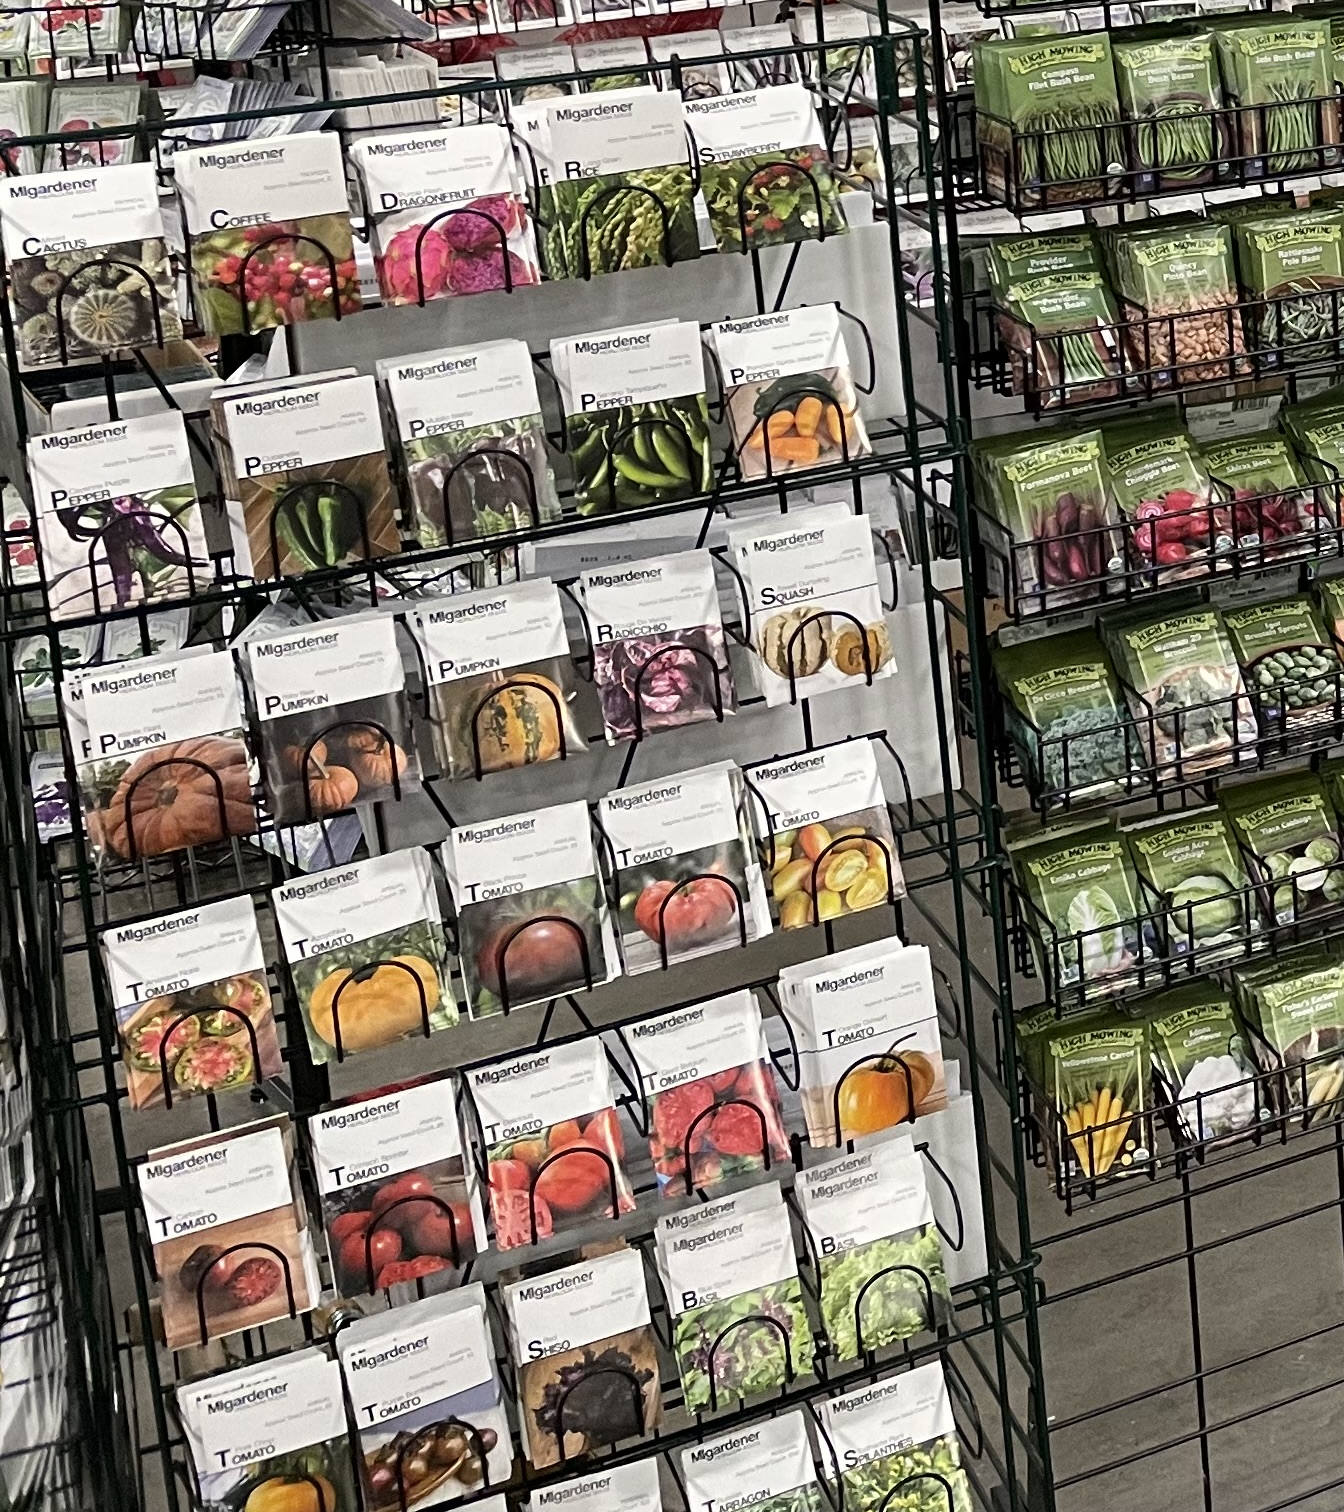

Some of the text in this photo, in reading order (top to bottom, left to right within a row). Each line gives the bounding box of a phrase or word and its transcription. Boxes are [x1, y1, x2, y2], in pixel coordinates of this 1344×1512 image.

[1273, 32, 1315, 43] MOWING
[1019, 44, 1094, 65] HIGH MOWING
[556, 101, 633, 122] MIgardener
[685, 94, 757, 114] MIgardener
[367, 136, 447, 156] MIgardener
[700, 142, 781, 163] STRAWBERRY
[199, 147, 285, 169] MIgardener
[565, 161, 600, 178] RICE
[10, 177, 97, 199] MIgardener
[380, 188, 475, 209] DRAGONFRUIT
[210, 210, 271, 229] COFFEE
[22, 237, 87, 256] CACTUS
[1009, 237, 1081, 253] HIGH MOWING
[1030, 256, 1067, 266] Provider
[1021, 273, 1091, 293] HIGH MOWING
[719, 313, 789, 334] MIgardener
[575, 332, 651, 353] MIgardener
[398, 355, 478, 380] MIgardener
[731, 368, 780, 384] PEPPER
[235, 391, 320, 416] MIgardener
[581, 393, 633, 411] PEPPER
[41, 425, 128, 450] MIgardener
[409, 419, 464, 437] PEPPER
[244, 456, 303, 476] PEPPER
[51, 489, 110, 509] PEPPER
[753, 528, 824, 552] MIgardener
[589, 567, 662, 588] MIgardener
[761, 586, 814, 605] SQUASH
[429, 598, 507, 624] MIgardener
[597, 622, 667, 642] RADICCHIO
[1137, 615, 1206, 641] HIGH MOWING
[257, 632, 339, 657] MIgardener
[439, 656, 500, 678] PUMPKIN
[91, 667, 178, 694] MIgardener
[265, 693, 329, 715] PUMPKIN
[101, 731, 167, 753] PUMPKIN
[756, 755, 825, 780] MIgardener
[608, 784, 682, 811] MIgardener
[458, 817, 536, 843] MIgardener
[768, 811, 820, 830] TOMATO
[617, 846, 673, 866] TOMATO
[1040, 844, 1111, 869] HIGH MOWING
[279, 869, 359, 901] MIgardener
[465, 881, 523, 902] TOMATO
[117, 912, 199, 943] MIgardener
[293, 933, 354, 958] TOMATO
[127, 977, 189, 1001] TOMATO
[815, 966, 884, 993] MIgardener
[632, 1007, 704, 1037] MIgardener
[822, 1026, 875, 1046] TOMATO
[1060, 1030, 1133, 1050] HIGH MOWING
[475, 1054, 550, 1085] MIgardener
[643, 1068, 699, 1091] TOMATO
[321, 1100, 400, 1129] MIgardener
[485, 1119, 543, 1139] TOMATO
[146, 1148, 228, 1179] MIgardener
[329, 1163, 389, 1186] TOMATO
[810, 1170, 879, 1199] MIgardener
[155, 1212, 218, 1236] TOMATO
[673, 1222, 744, 1252] MIgardener
[821, 1236, 858, 1254] BASIL
[519, 1269, 594, 1301] MIgardener
[681, 1290, 721, 1309] BASIL
[352, 1336, 429, 1371] MIgardener
[527, 1340, 570, 1358] SHISO
[208, 1381, 288, 1414] MIgardener
[362, 1395, 421, 1422] TOMATO
[832, 1382, 898, 1414] MIgardener
[215, 1445, 276, 1468] TOMATO
[691, 1430, 760, 1463] MIgardener
[843, 1437, 913, 1468] SPILANTHES
[539, 1477, 611, 1505] MIgardener
[703, 1488, 770, 1512] TARRAGON
